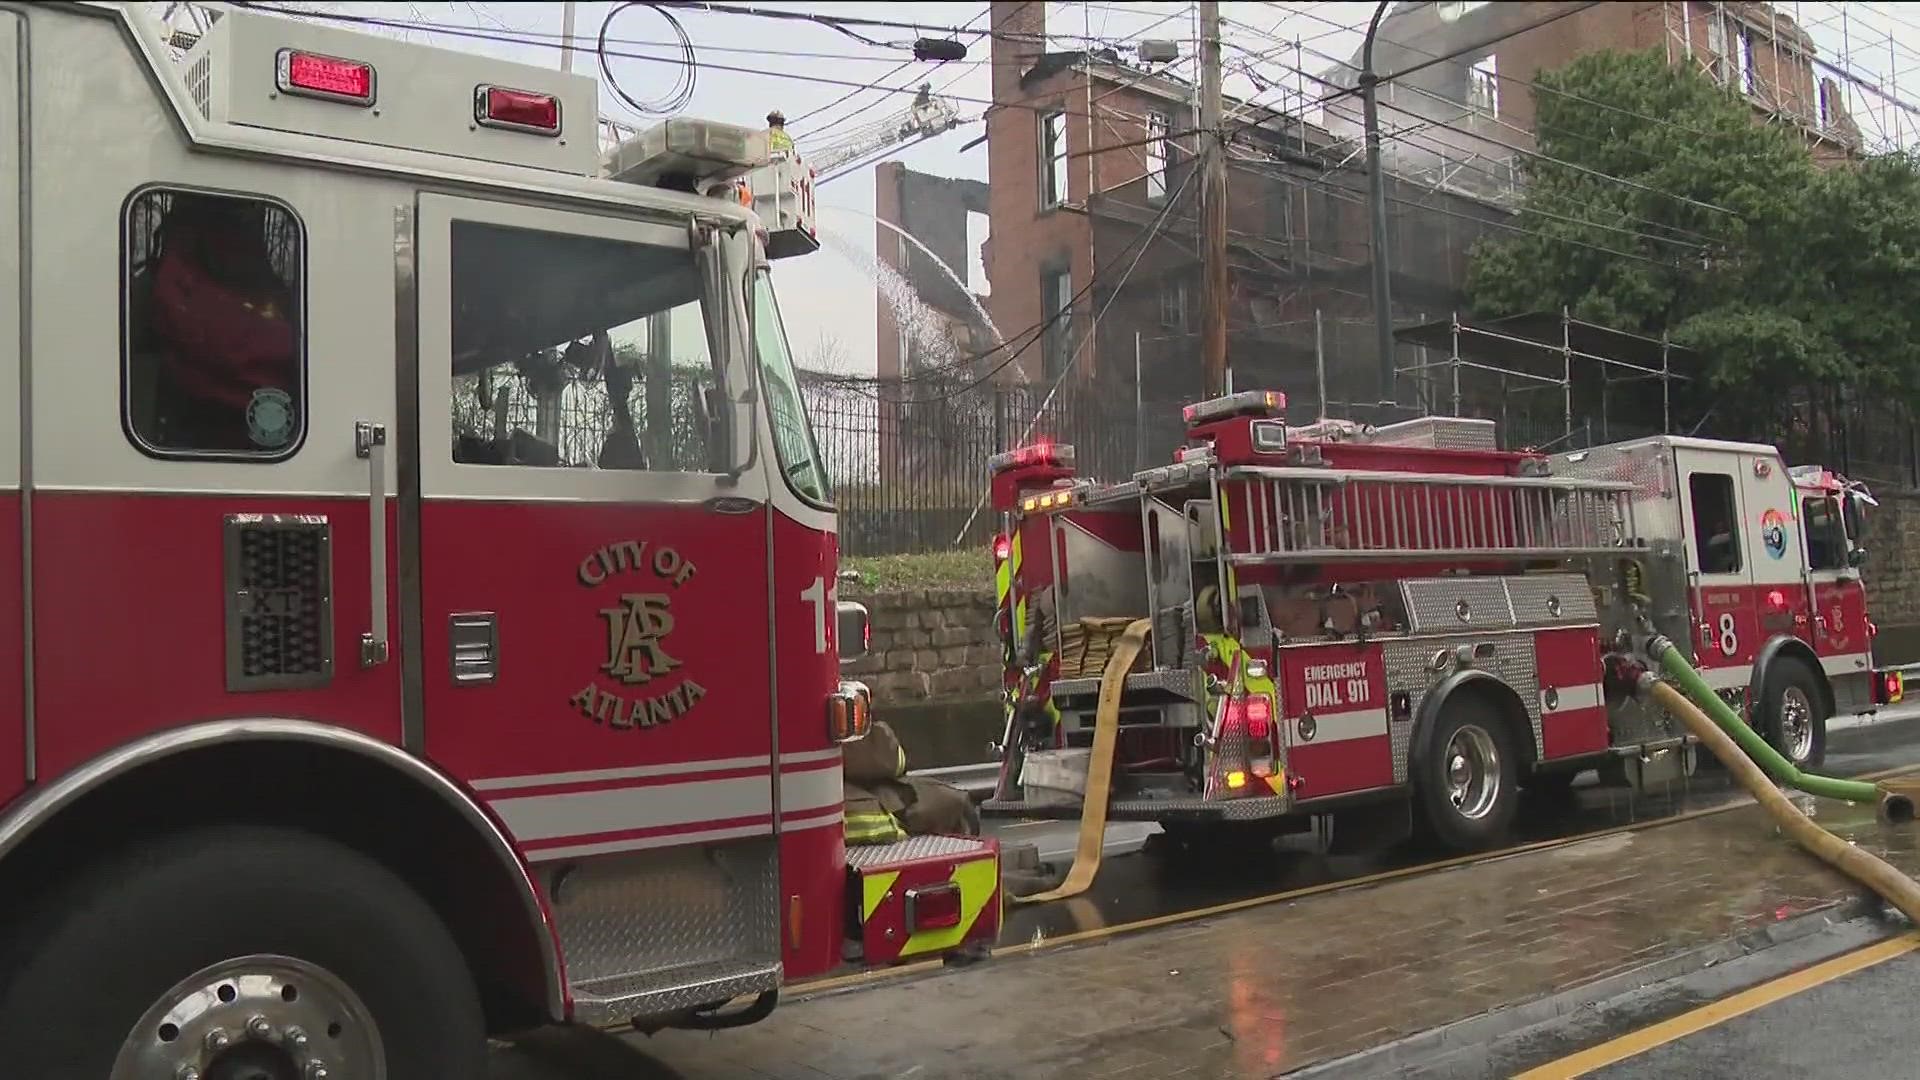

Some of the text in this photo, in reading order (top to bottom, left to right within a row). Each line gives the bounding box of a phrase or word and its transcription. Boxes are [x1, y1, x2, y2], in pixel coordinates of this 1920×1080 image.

[577, 540, 697, 586] CITY OF
[1719, 613, 1738, 656] 8
[1304, 662, 1367, 680] EMERGENCY
[570, 678, 707, 729] ATLANTA
[1305, 679, 1370, 708] DIAL 911
